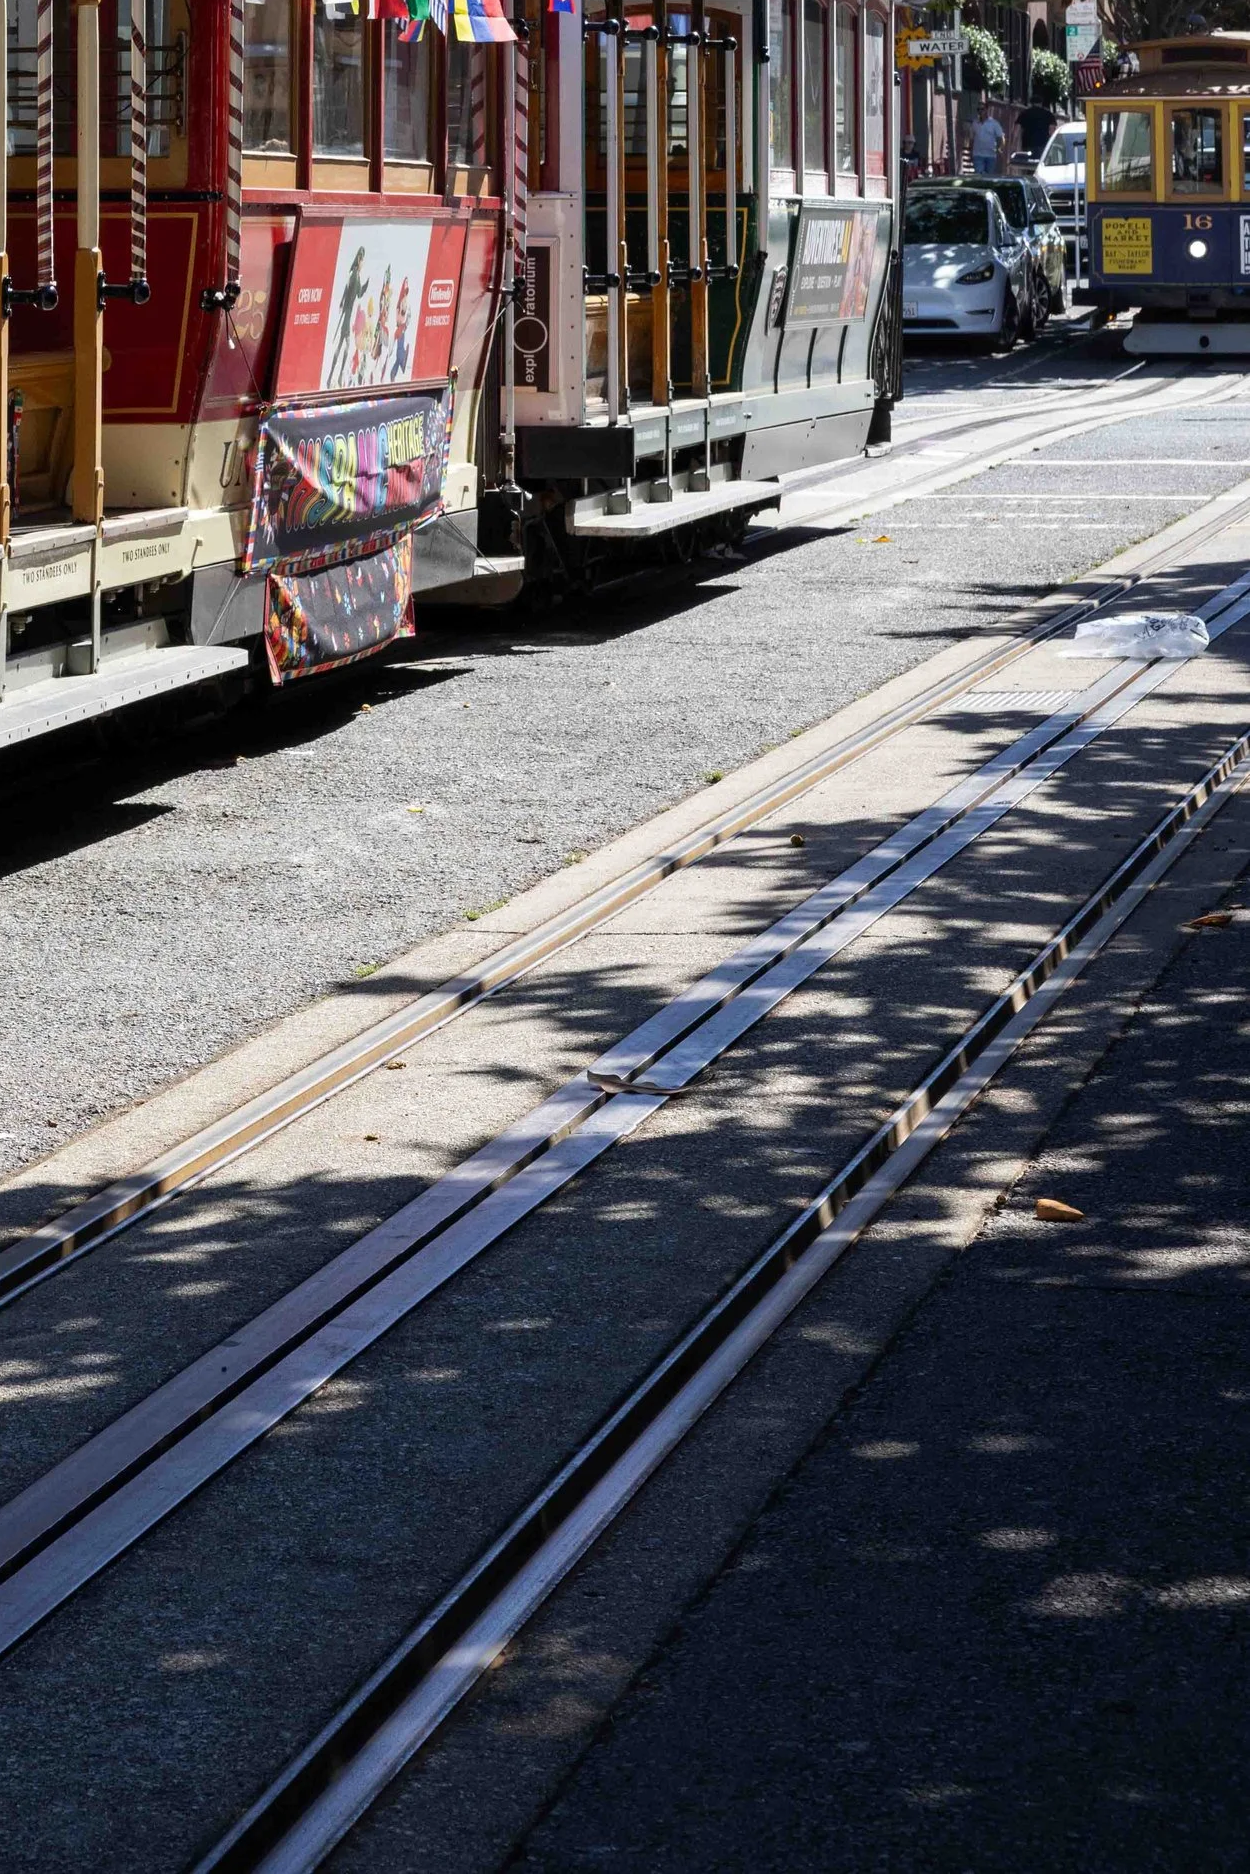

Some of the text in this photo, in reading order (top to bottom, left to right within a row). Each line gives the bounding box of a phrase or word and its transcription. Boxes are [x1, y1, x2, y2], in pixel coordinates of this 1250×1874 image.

[919, 42, 964, 52] WATER
[1105, 222, 1149, 230] POWELL
[1183, 214, 1212, 230] 16
[387, 411, 425, 467] HERITAGE
[122, 543, 170, 563] TWO STANDEES ONLY
[22, 562, 77, 585] TWO STANDEES ONLY
